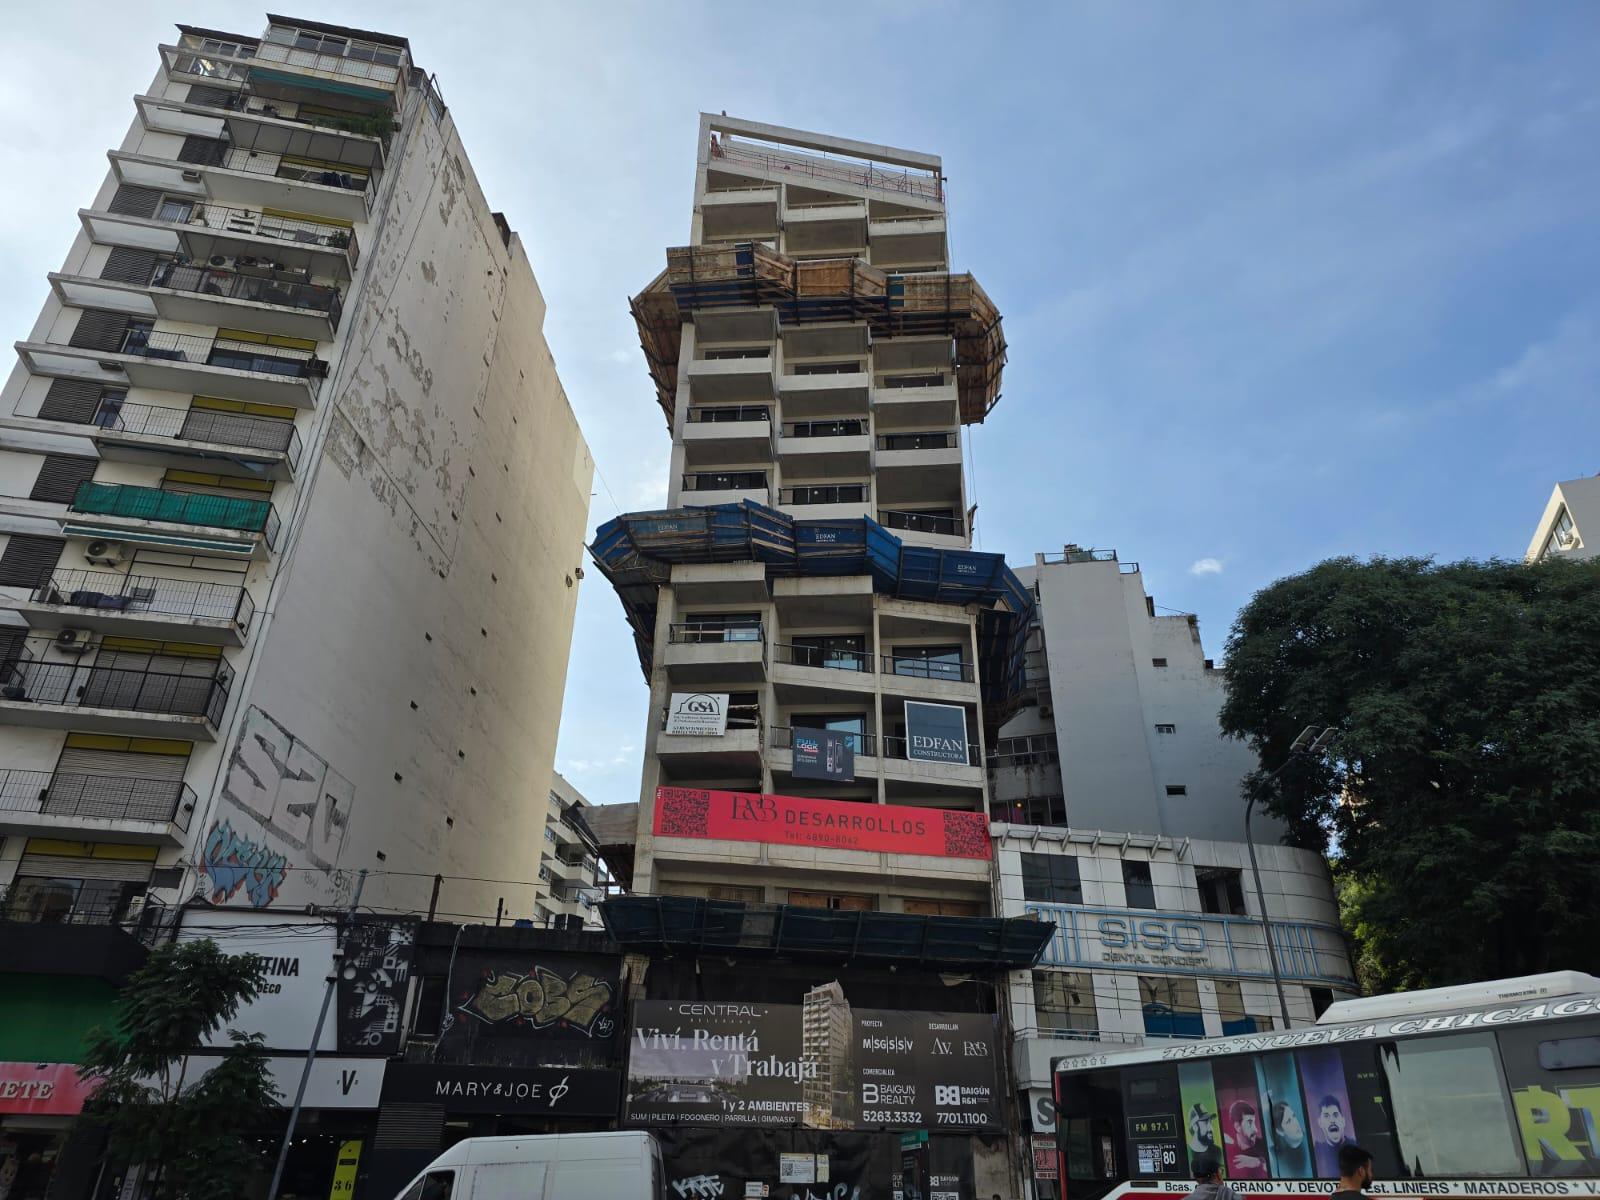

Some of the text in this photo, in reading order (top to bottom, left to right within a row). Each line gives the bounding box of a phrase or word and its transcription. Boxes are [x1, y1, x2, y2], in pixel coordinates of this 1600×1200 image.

[687, 701, 714, 712] GSA
[912, 735, 963, 751] EDFAN
[913, 750, 964, 760] CONSTRUCTORA
[785, 810, 926, 836] DESARROLLOS
[1097, 918, 1205, 952] SISO
[1102, 952, 1208, 967] DENTAL CONCEPT
[679, 1004, 762, 1017] CENTRAL
[1389, 998, 1600, 1034] CHICAG
[693, 1028, 759, 1052] Rentá
[728, 1054, 818, 1085] Trabajá
[0, 1080, 54, 1099] ETE
[342, 1070, 357, 1096] V
[721, 1100, 810, 1113] 1 y 2 AMBIENTES
[880, 1095, 916, 1105] REALTY
[630, 1113, 796, 1123] SUM PILETA FOGONERO PARRILLA GIMNASIO
[862, 1110, 922, 1123] 5263.3332
[936, 1112, 988, 1124] 7701.1100
[1135, 1122, 1169, 1132] FM 97.1
[1163, 1151, 1176, 1165] 80
[1165, 1182, 1193, 1192] Bcas.
[1225, 1182, 1274, 1193] GRANO
[1284, 1183, 1295, 1193] V.
[1298, 1182, 1340, 1193] DEVOT
[1393, 1182, 1449, 1194] LINIERS
[1464, 1182, 1569, 1194] MATADEROS
